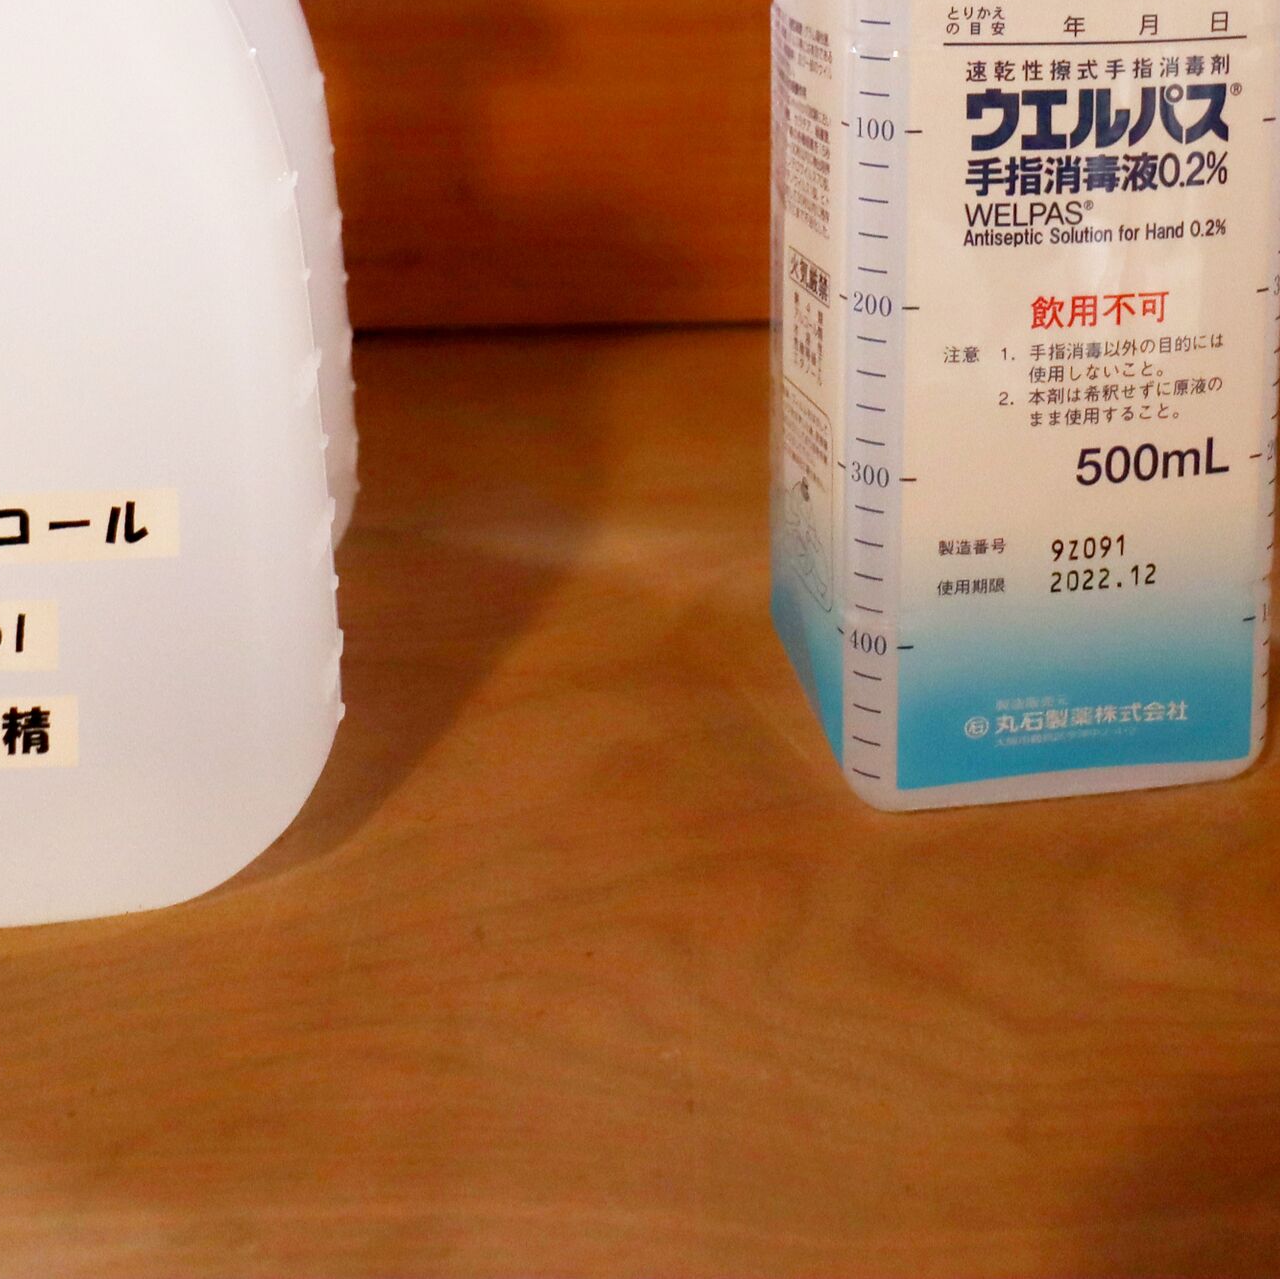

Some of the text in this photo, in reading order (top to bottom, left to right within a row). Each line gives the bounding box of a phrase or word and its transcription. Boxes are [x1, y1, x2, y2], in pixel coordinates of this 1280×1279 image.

[947, 6, 1006, 20] とりかえ
[1063, 10, 1229, 38] 年 月 日
[946, 21, 1006, 36] の目安
[966, 54, 1231, 83] 速乾性擦式手指消毒剤
[856, 117, 895, 141] 100
[965, 150, 1228, 197] 手指消毒液0.2%
[963, 218, 1227, 247] Antiseptic Solution for Hand 0.2%
[853, 291, 892, 317] 200
[1031, 291, 1169, 330] 飲用不可
[943, 333, 1224, 364] 注意 1. 手指消毒以外の目的には
[1029, 361, 1166, 384] 使用しないこと。
[999, 376, 1223, 406] 2. 本剤は希釈せずに原液の
[1030, 403, 1181, 427] まま使用すること。
[851, 462, 890, 488] 300
[1076, 436, 1230, 486] 500mL
[938, 534, 1126, 562] 製造番号 9Z091
[936, 563, 1157, 597] 使用期限 2022.12
[849, 629, 887, 656] 400
[995, 700, 1189, 734] 丸石製薬株式会社
